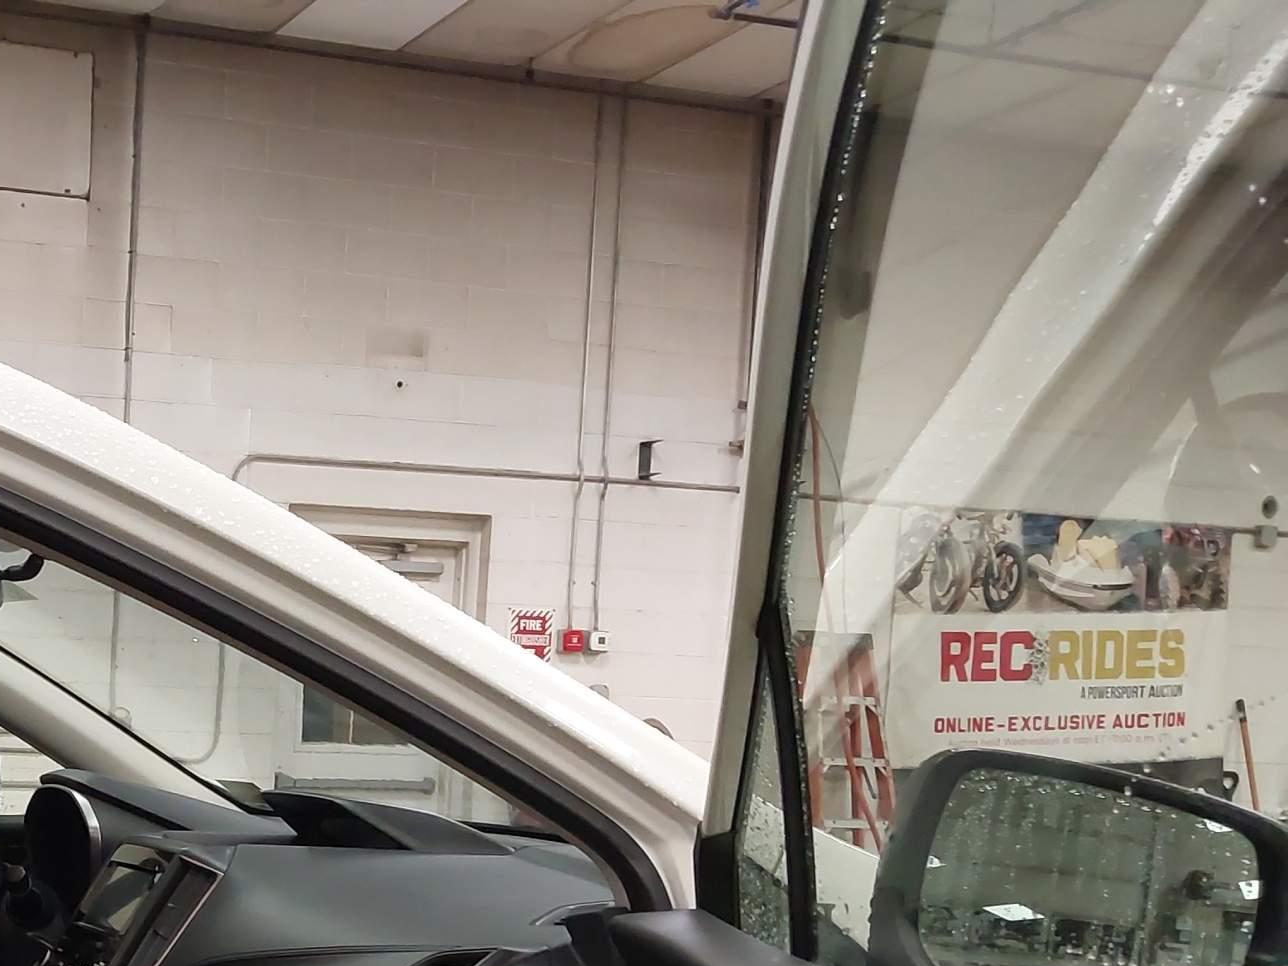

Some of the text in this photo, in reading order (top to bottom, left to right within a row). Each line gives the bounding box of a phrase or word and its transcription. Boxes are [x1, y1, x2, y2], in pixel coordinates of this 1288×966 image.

[519, 619, 543, 631] FIRE
[940, 628, 1186, 683] REC RIDES
[1080, 685, 1184, 699] A POWERSPORT AUCTION
[934, 711, 1186, 734] ONLINE-EXCLUSIVE AUCTION
